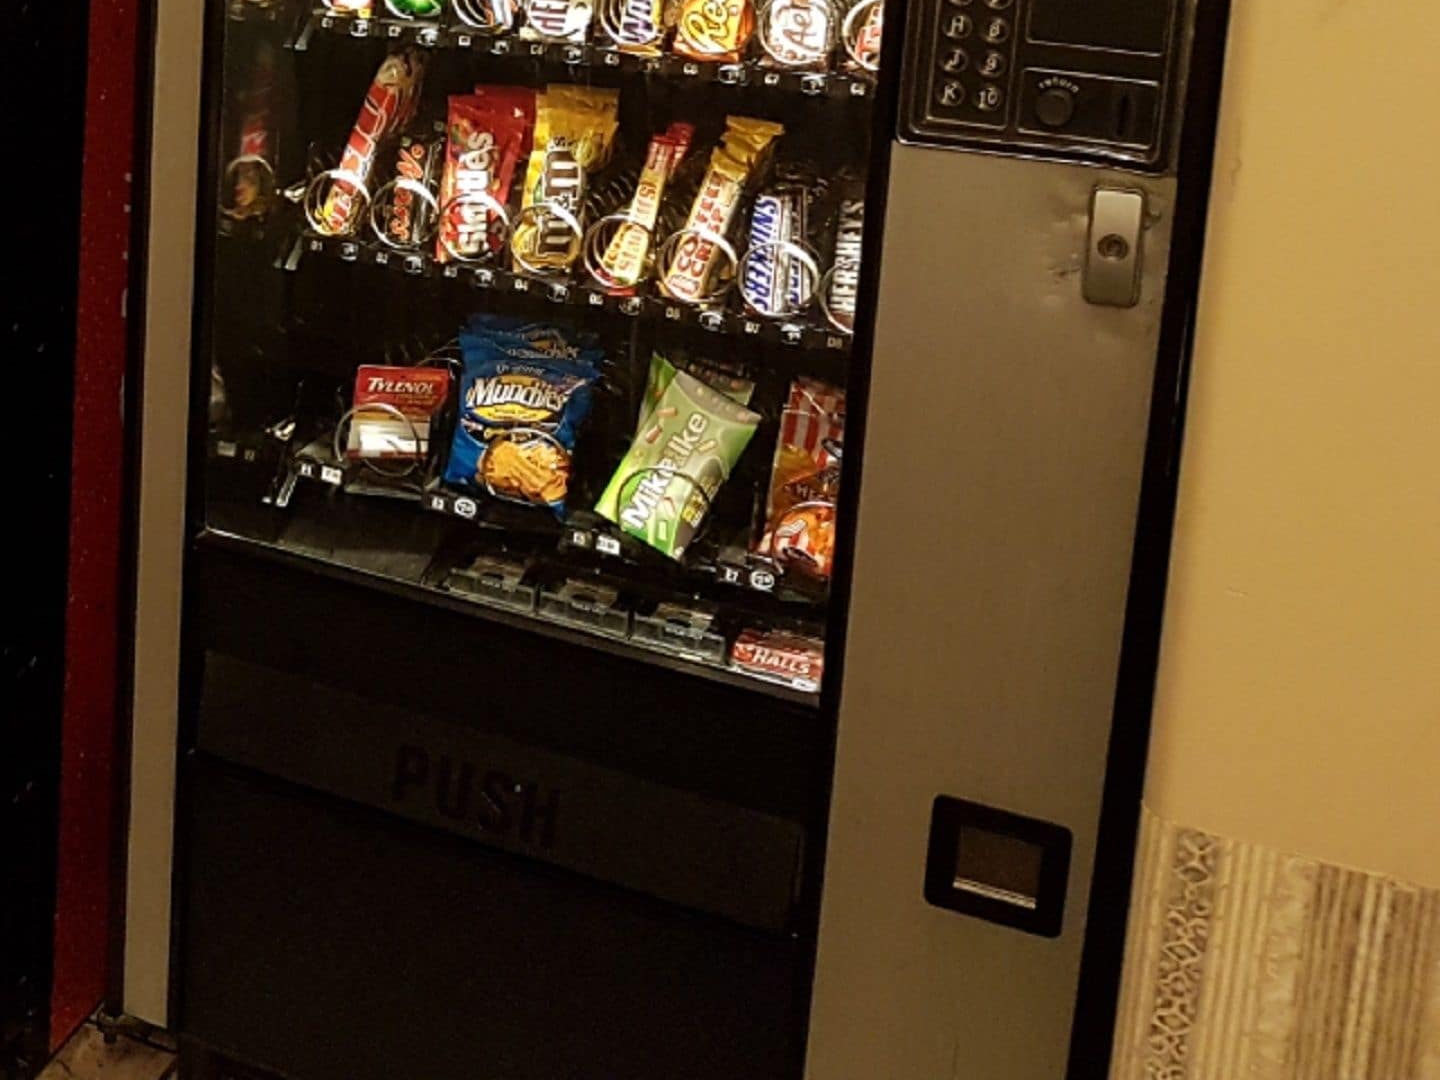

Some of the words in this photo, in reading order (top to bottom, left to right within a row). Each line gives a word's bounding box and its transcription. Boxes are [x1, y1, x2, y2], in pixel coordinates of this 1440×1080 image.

[744, 195, 781, 311] SNICKERS
[830, 199, 866, 317] HERSHEY'S
[367, 376, 435, 395] TYLENOL
[465, 376, 569, 413] Munchies
[620, 455, 677, 530] Mike
[751, 647, 813, 675] HALLS
[395, 744, 560, 851] PUSH
